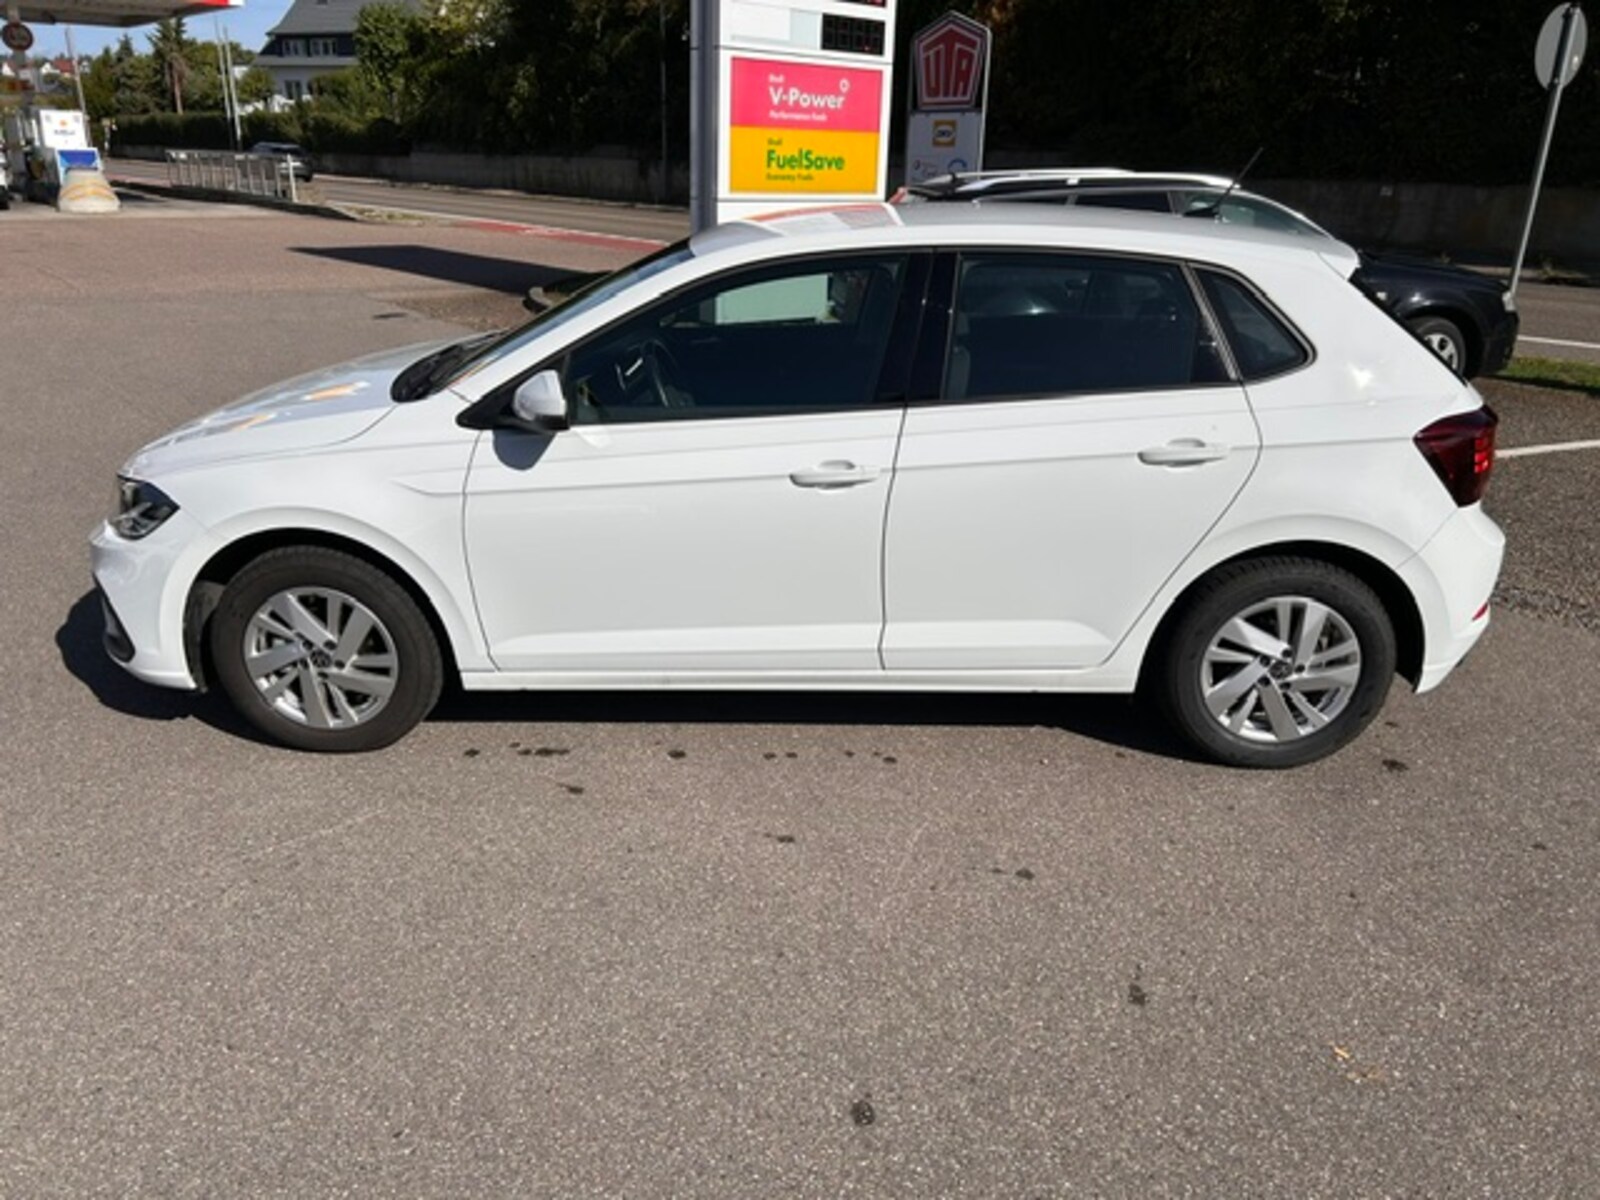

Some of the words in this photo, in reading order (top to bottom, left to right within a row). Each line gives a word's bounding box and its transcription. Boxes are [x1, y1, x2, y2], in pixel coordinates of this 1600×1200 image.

[923, 25, 978, 98] UTA
[769, 86, 845, 109] V-Power
[766, 148, 845, 170] FuelSave
